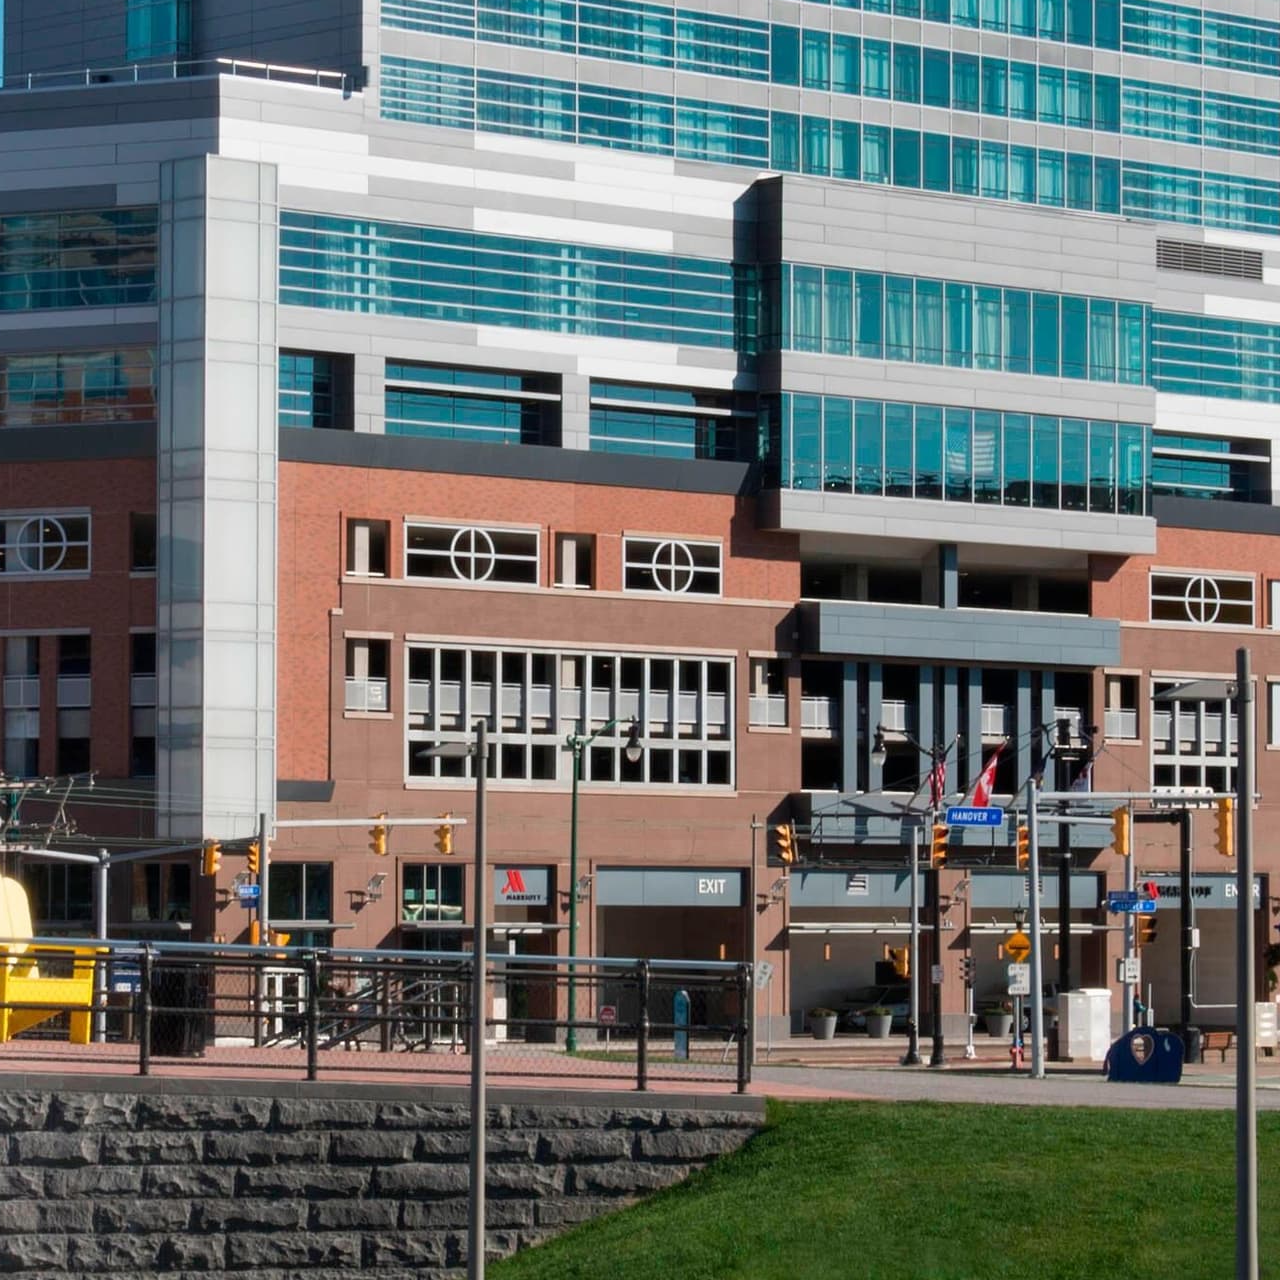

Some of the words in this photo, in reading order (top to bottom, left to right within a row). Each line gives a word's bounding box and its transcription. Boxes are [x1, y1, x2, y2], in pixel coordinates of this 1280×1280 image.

[952, 811, 988, 822] HANOVER
[699, 879, 726, 894] EXIT
[1225, 883, 1260, 897] ENR
